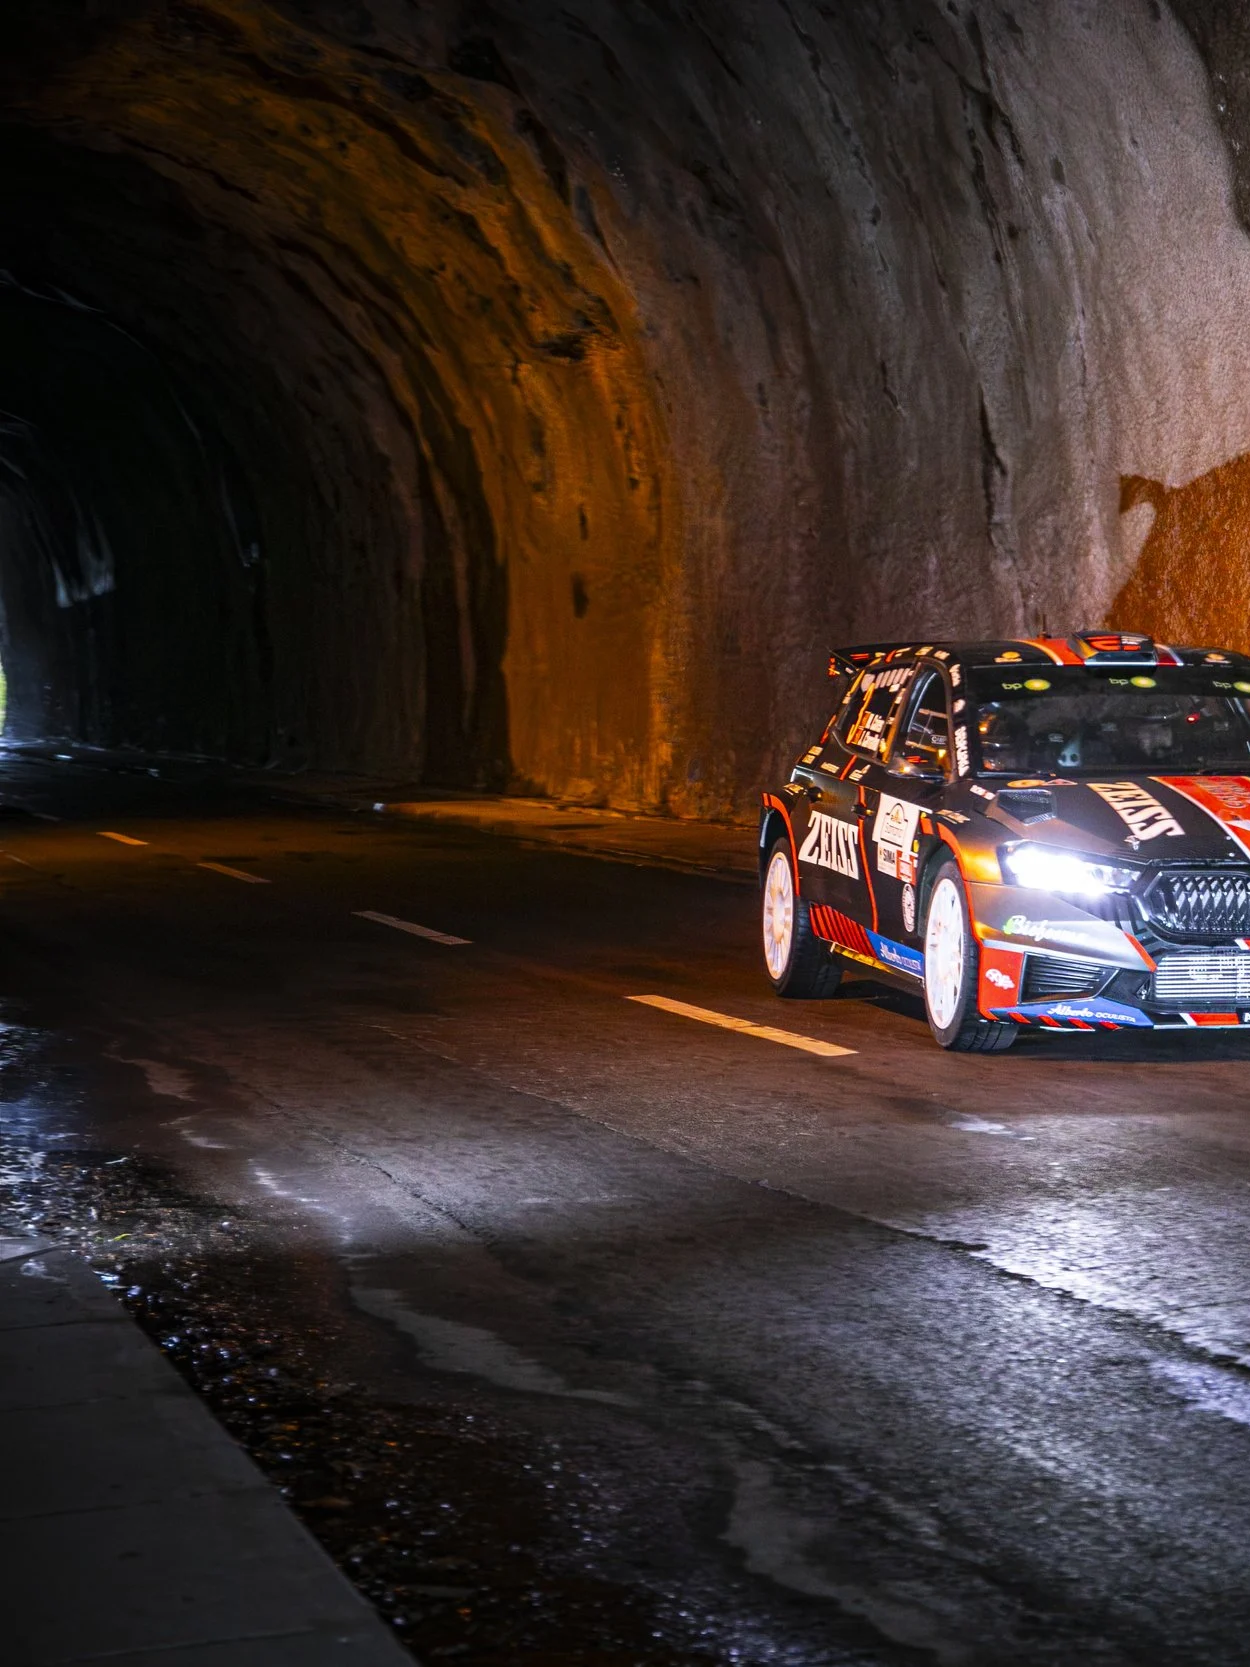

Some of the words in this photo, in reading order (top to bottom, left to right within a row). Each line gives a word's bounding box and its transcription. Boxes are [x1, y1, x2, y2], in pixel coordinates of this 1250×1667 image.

[1002, 682, 1022, 691] bp
[1109, 678, 1129, 686] bp
[1212, 680, 1232, 690] bp
[1086, 781, 1186, 841] ZEISS
[798, 810, 859, 880] ZEISS
[1047, 1004, 1094, 1018] Alberto
[1095, 1011, 1136, 1022] OCULISTA
